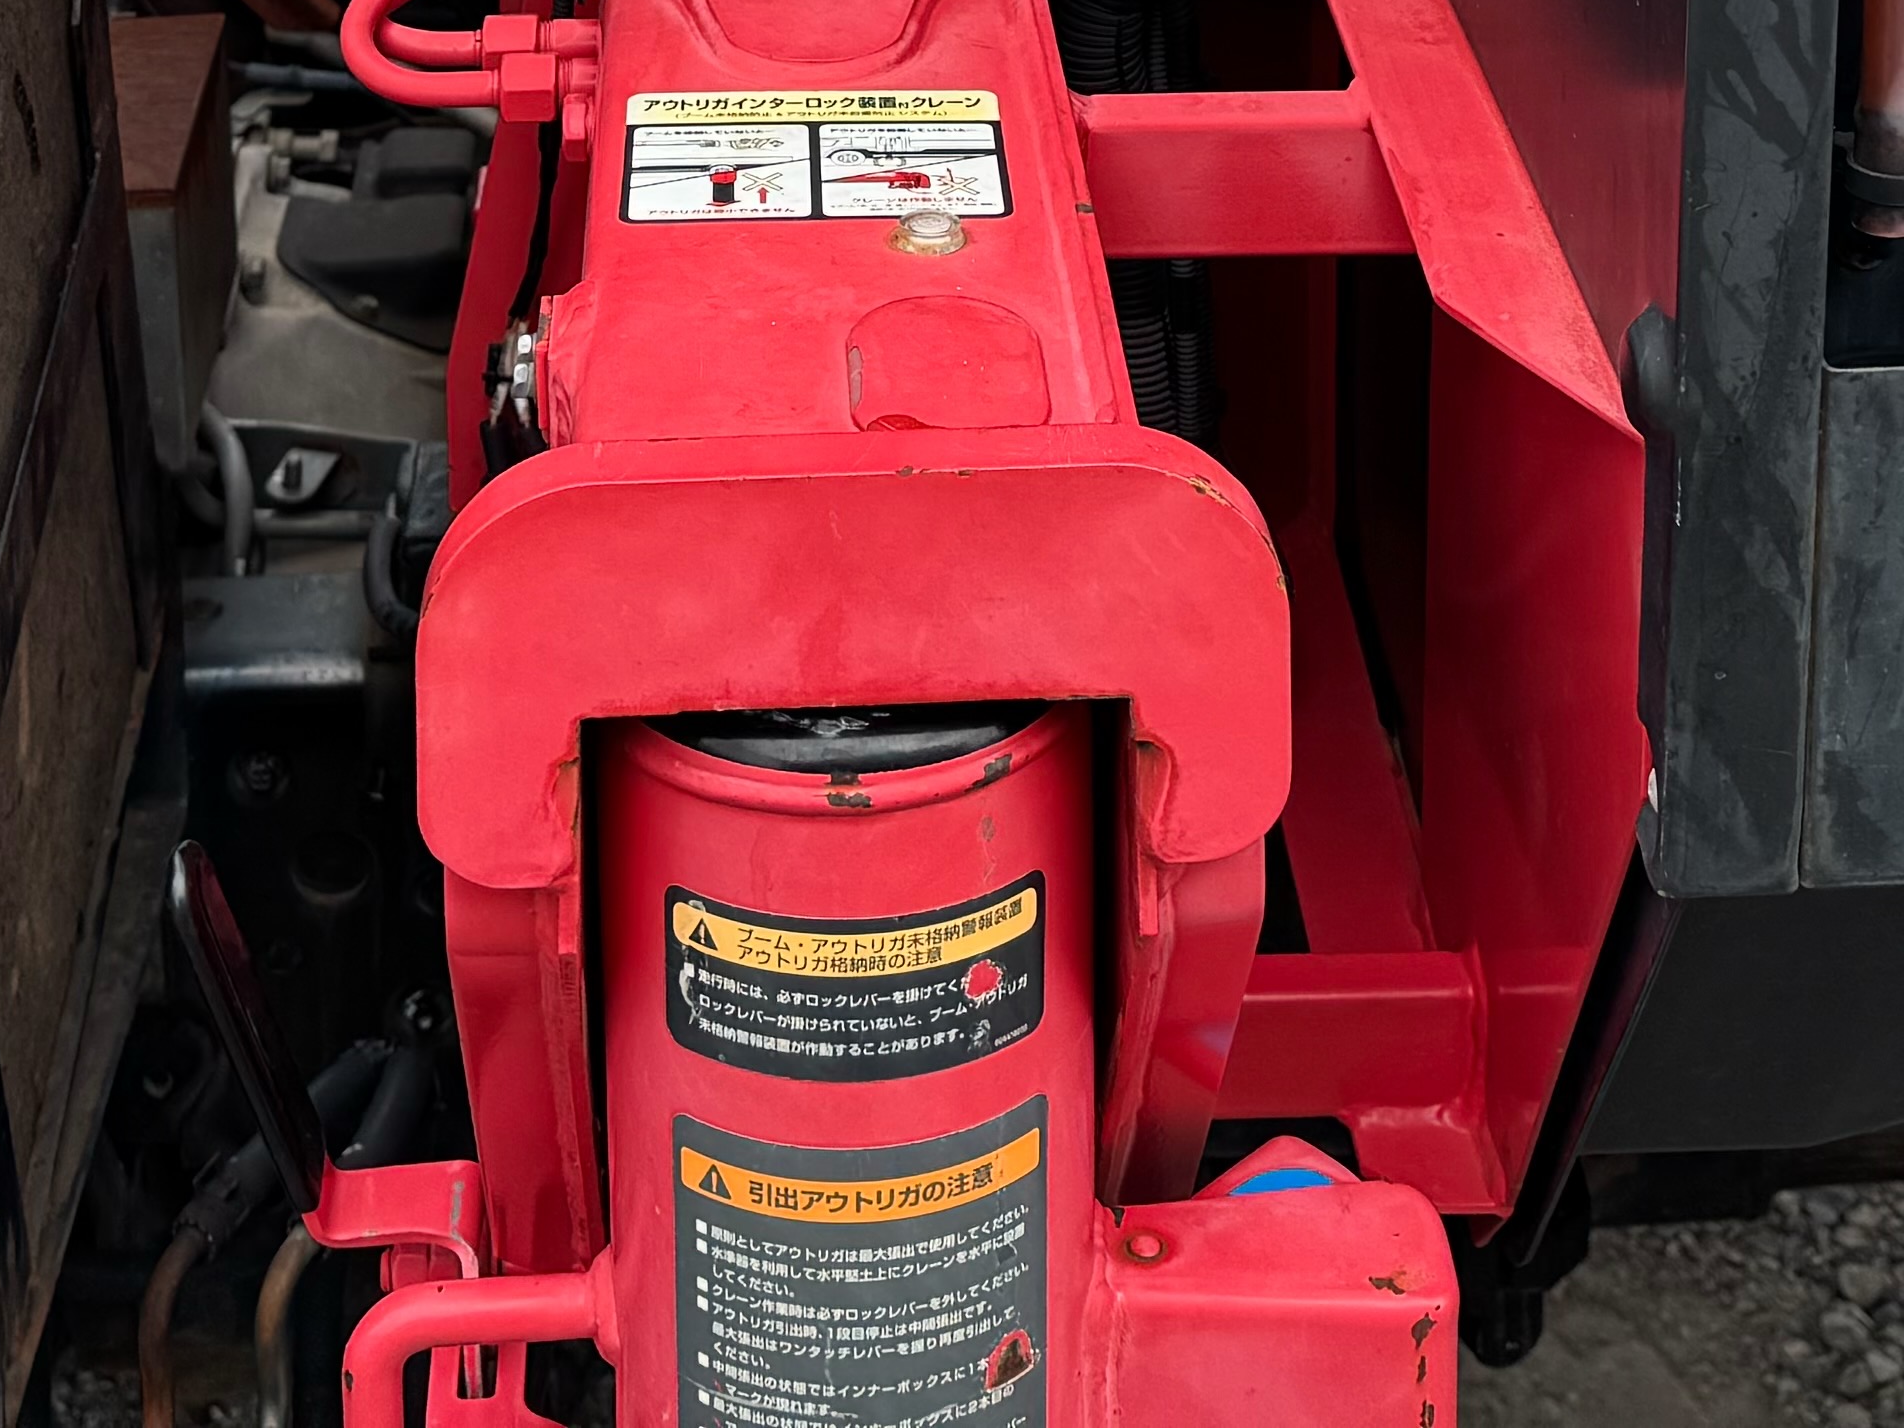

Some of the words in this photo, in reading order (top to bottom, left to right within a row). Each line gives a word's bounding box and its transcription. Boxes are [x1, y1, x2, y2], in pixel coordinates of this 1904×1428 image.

[737, 896, 1023, 953] ブーム・アウトリガ未格納警報装置
[738, 945, 943, 973] アウトリガ格納時の注意
[699, 1017, 965, 1057] 未格納警報装置が作動することがあります。
[749, 1163, 994, 1213] 引出アウトリガの注意
[711, 1204, 1029, 1263] 原則としてアウトリガは最大張出で使用してください。
[712, 1264, 796, 1298] してください。
[712, 1263, 1029, 1322] クレーン作業時は必ずロックレバーを外してください。
[713, 1342, 772, 1370] ください。
